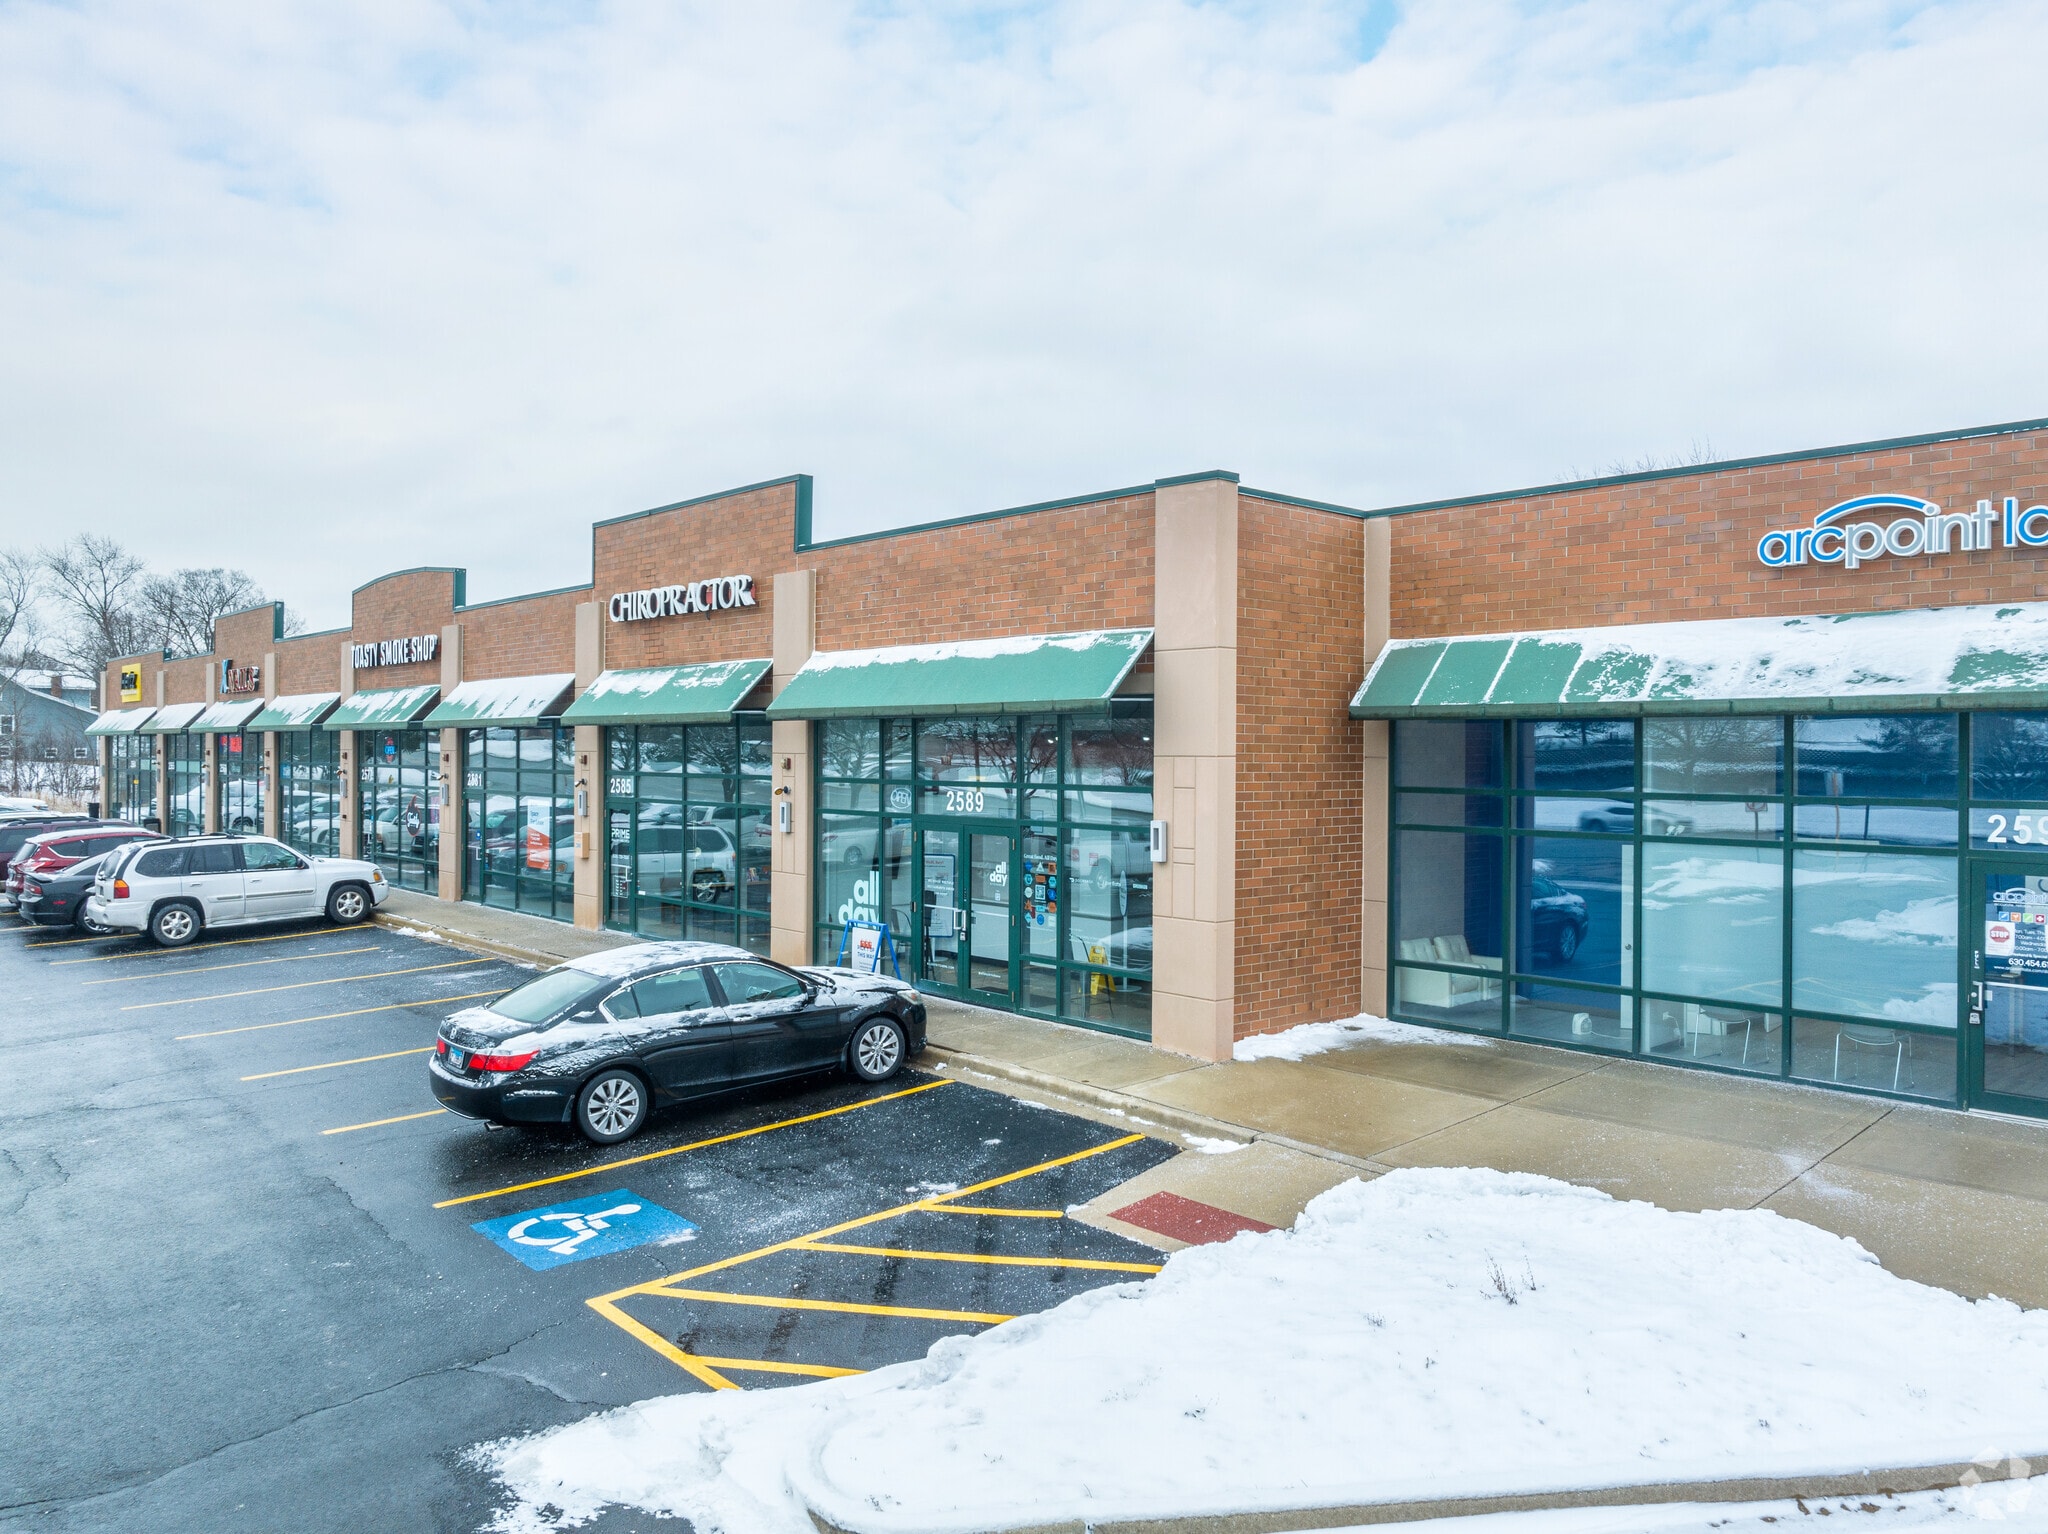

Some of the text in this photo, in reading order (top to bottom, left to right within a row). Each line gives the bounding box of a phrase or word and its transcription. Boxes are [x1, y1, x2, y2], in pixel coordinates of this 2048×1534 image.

[1758, 493, 1999, 570] arcpoint
[608, 574, 756, 623] CHIROPRACTOR
[351, 634, 438, 669] TOASTY SMOKE SHOP
[610, 778, 631, 794] 2585
[946, 791, 984, 813] 2589
[611, 828, 630, 839] PRIME
[995, 861, 1007, 874] all
[853, 870, 880, 906] all
[989, 871, 1008, 886] day
[1990, 930, 2010, 938] STOP
